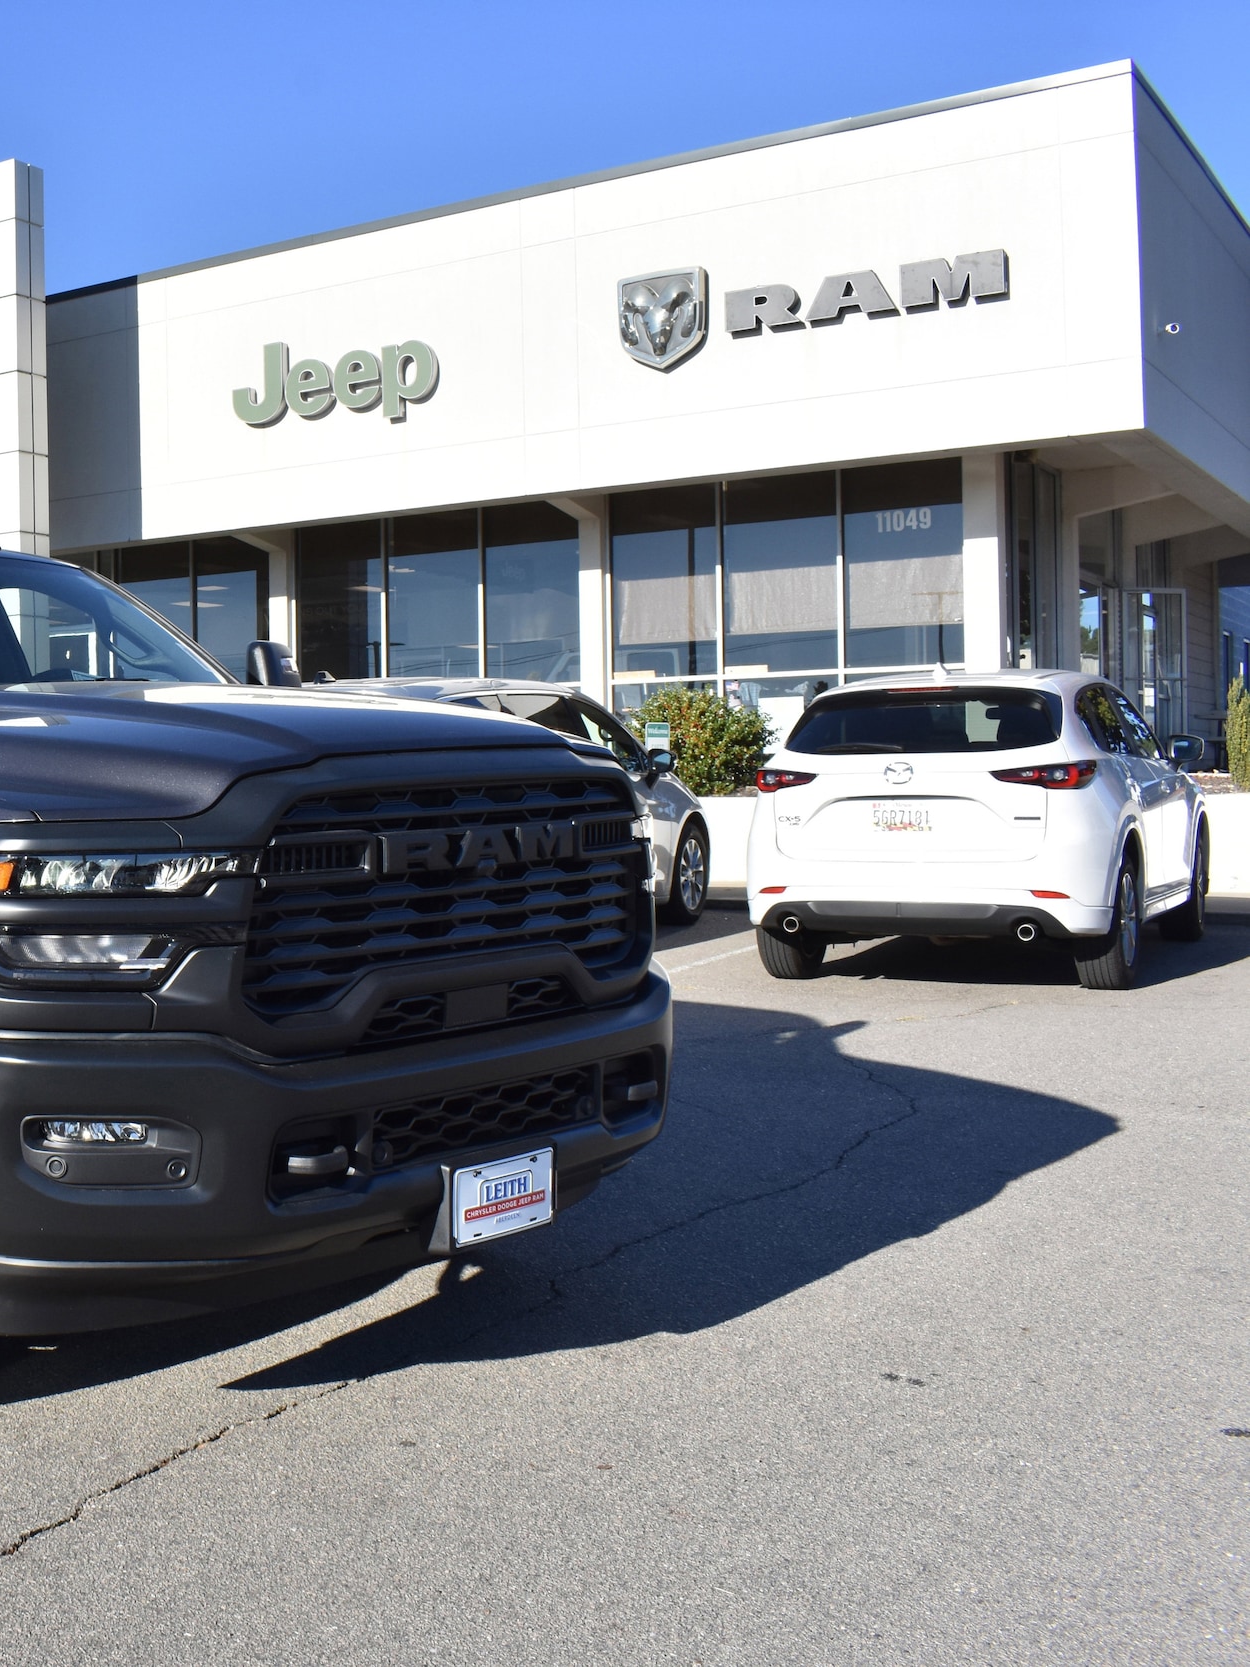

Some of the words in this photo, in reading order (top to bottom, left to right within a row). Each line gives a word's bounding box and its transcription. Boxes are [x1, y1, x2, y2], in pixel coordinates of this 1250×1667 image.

[725, 249, 1008, 337] RAM
[232, 340, 439, 427] Jeep
[876, 508, 931, 533] 11049
[378, 820, 573, 874] RAM
[466, 1206, 496, 1219] CHRYSLER
[497, 1201, 517, 1212] DODGE
[518, 1197, 532, 1206] JEEP
[532, 1193, 544, 1201] RAM
[485, 1175, 528, 1203] LEITH
